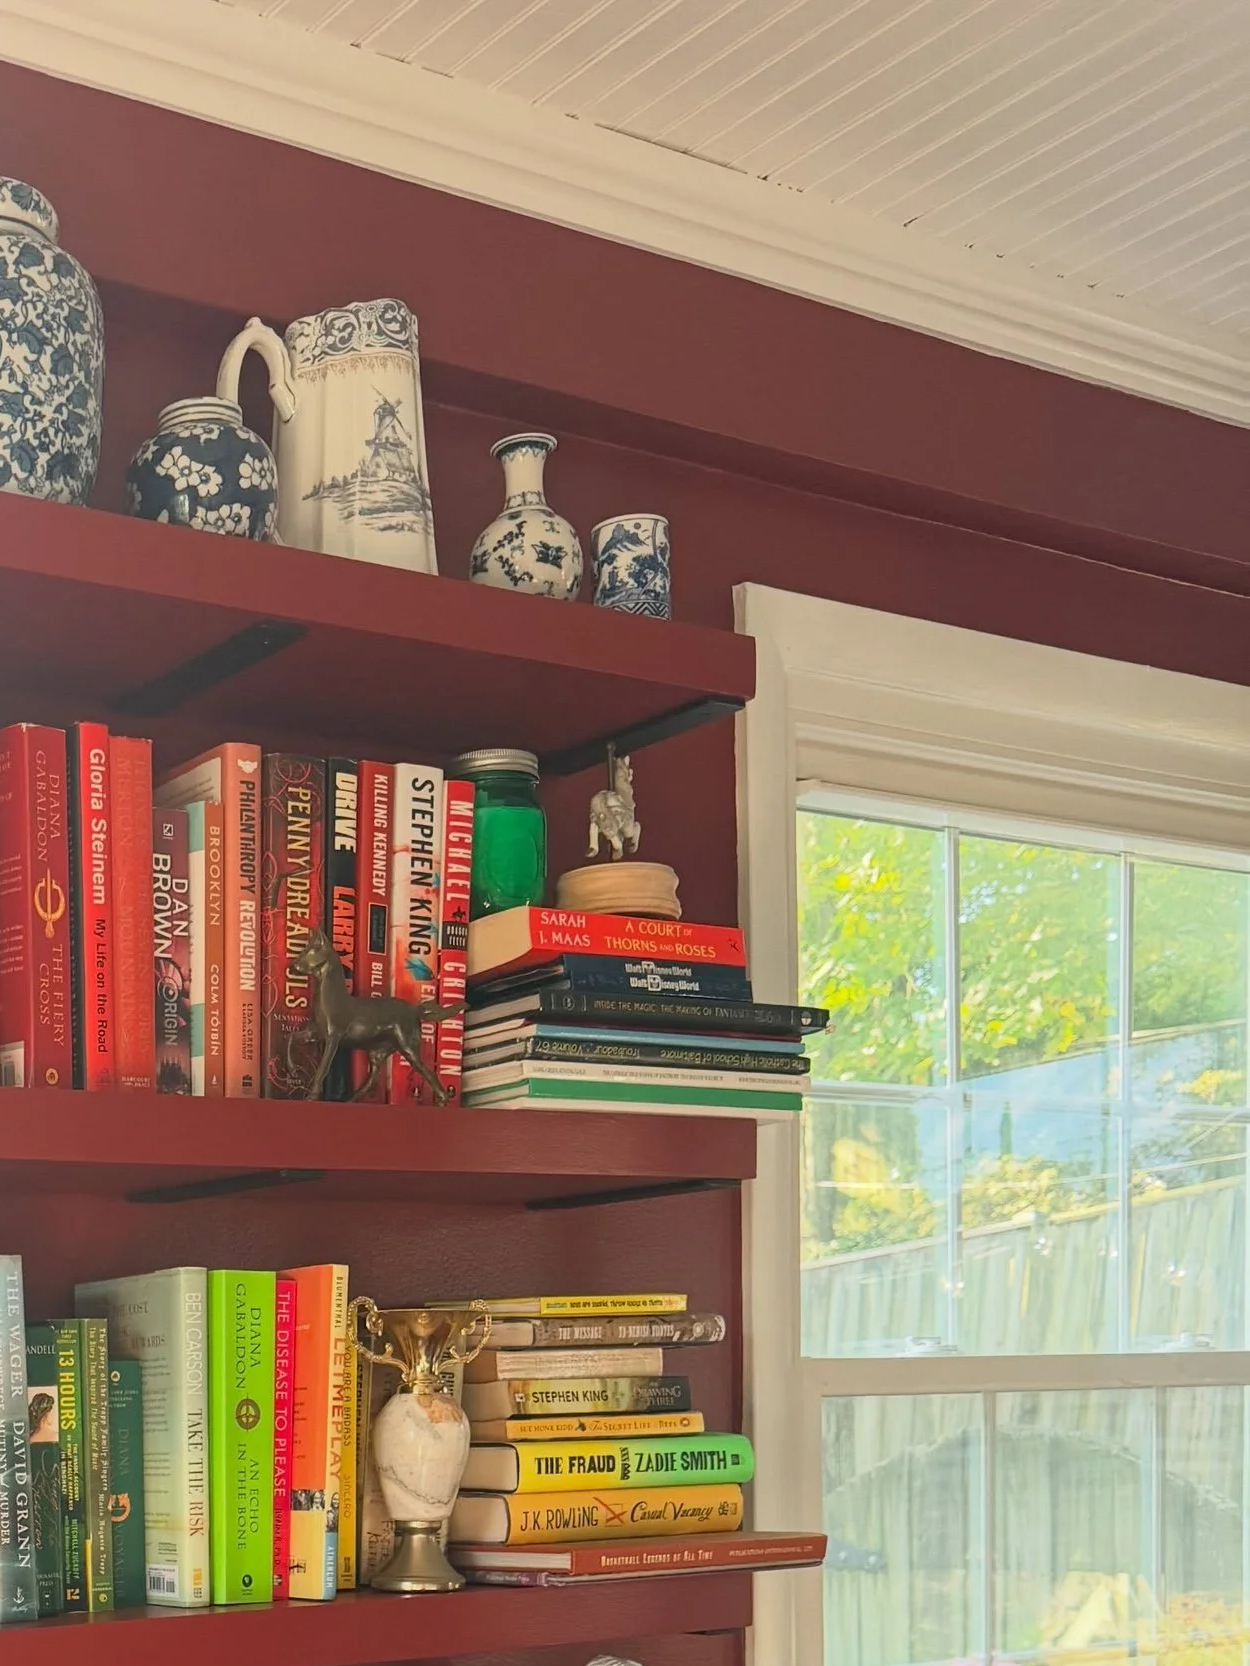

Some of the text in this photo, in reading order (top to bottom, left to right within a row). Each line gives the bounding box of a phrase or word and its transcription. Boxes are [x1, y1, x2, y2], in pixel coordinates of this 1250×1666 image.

[35, 749, 49, 862] GABALDON
[48, 774, 61, 840] DIANA
[88, 748, 107, 905] Gloria Steinem
[334, 772, 357, 853] DRIVE
[371, 774, 388, 898] KILLING KENNEDY
[446, 799, 473, 902] MICHAEL
[152, 853, 172, 959] BROWN
[171, 878, 189, 937] DAN
[209, 825, 221, 926] BROOKLYN
[239, 779, 256, 992] PHILANTHROPY REVOLUTION
[407, 777, 435, 957] STEPHEN KING
[540, 911, 587, 929] SARAH
[604, 935, 658, 953] THORNS
[675, 943, 717, 958] ROSES
[38, 962, 50, 1026] CROSS
[51, 943, 65, 1046] THE FIERY
[235, 1282, 247, 1389] GABALDON
[250, 1306, 262, 1369] DIANA
[5, 1271, 32, 1569] THE WAGER DAVID GRANN
[59, 1349, 76, 1430] 13 HOURS
[184, 1292, 205, 1537] BEN CARSON TAKE THE RISK
[273, 1291, 291, 1498] THE DISEASE TO PLEASE
[531, 1388, 609, 1404] STEPHEN KING
[534, 1454, 616, 1476] THE FRAUD
[635, 1450, 727, 1474] ZADIE SMITH
